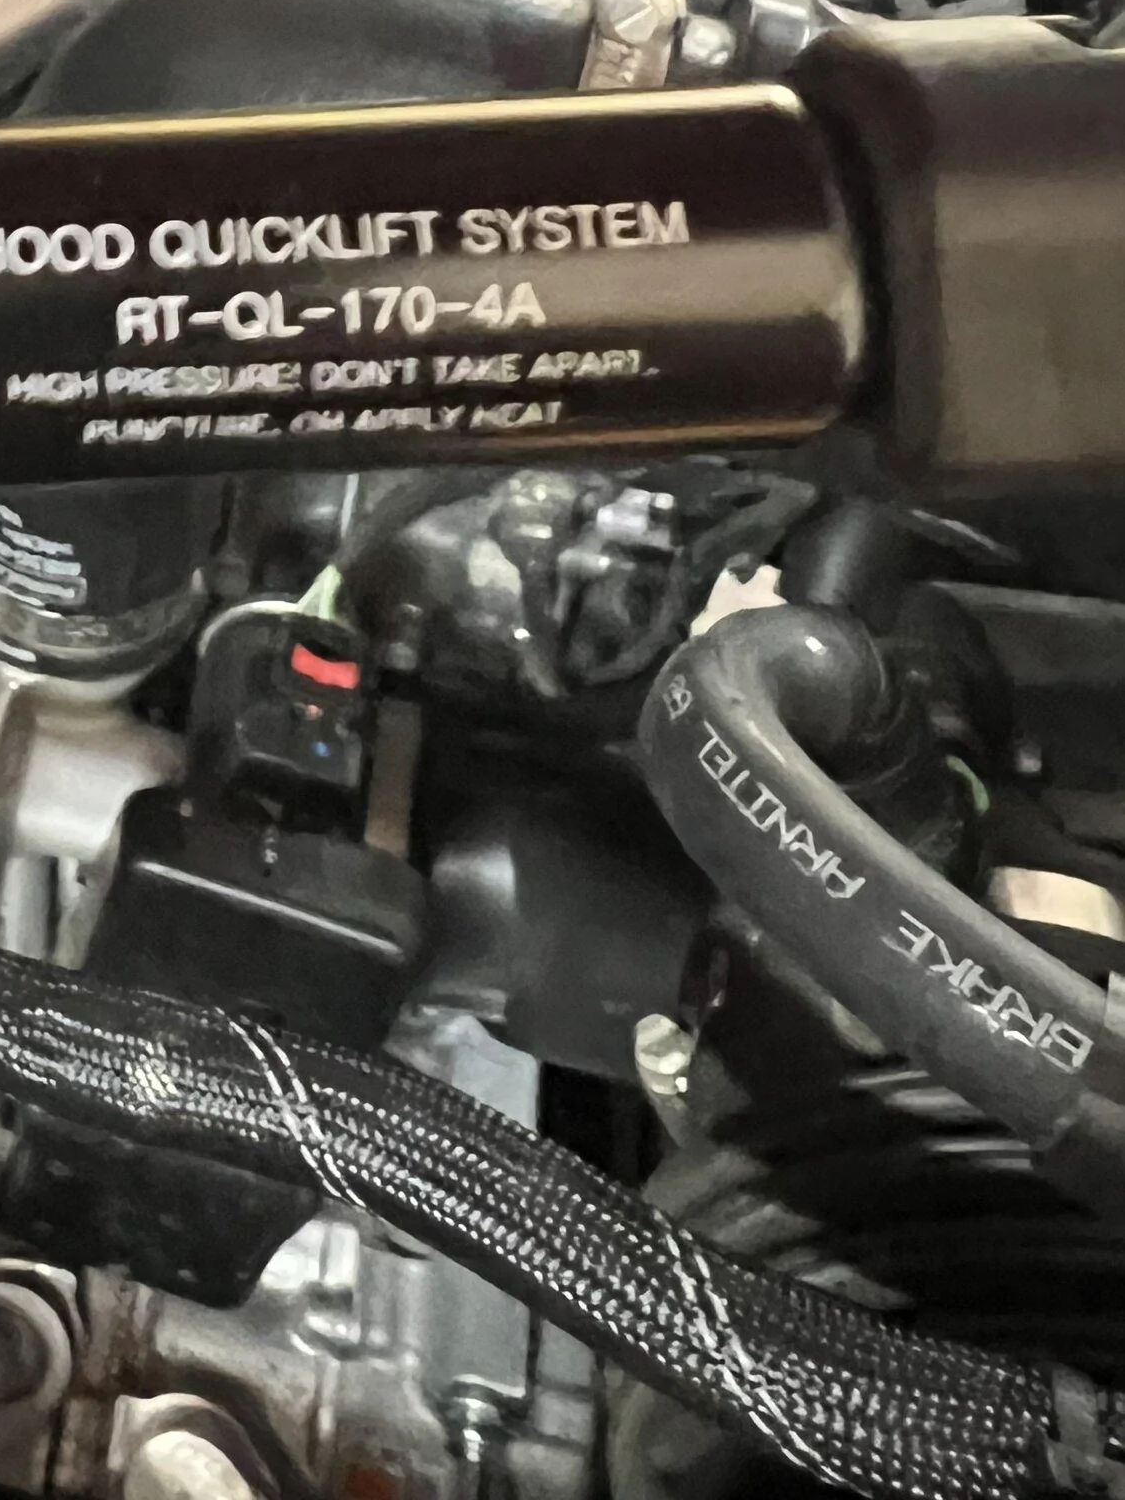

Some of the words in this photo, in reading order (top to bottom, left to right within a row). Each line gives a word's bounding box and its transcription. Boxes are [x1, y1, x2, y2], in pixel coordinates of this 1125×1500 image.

[148, 209, 441, 269] QUICKLIFT
[457, 200, 691, 255] SYSTEM
[115, 281, 548, 346] RT-QL-170-4A
[5, 368, 100, 405] HIGH
[309, 356, 421, 393] DON'T
[431, 352, 525, 386] TAKE
[880, 908, 1095, 1075] BRAKE
